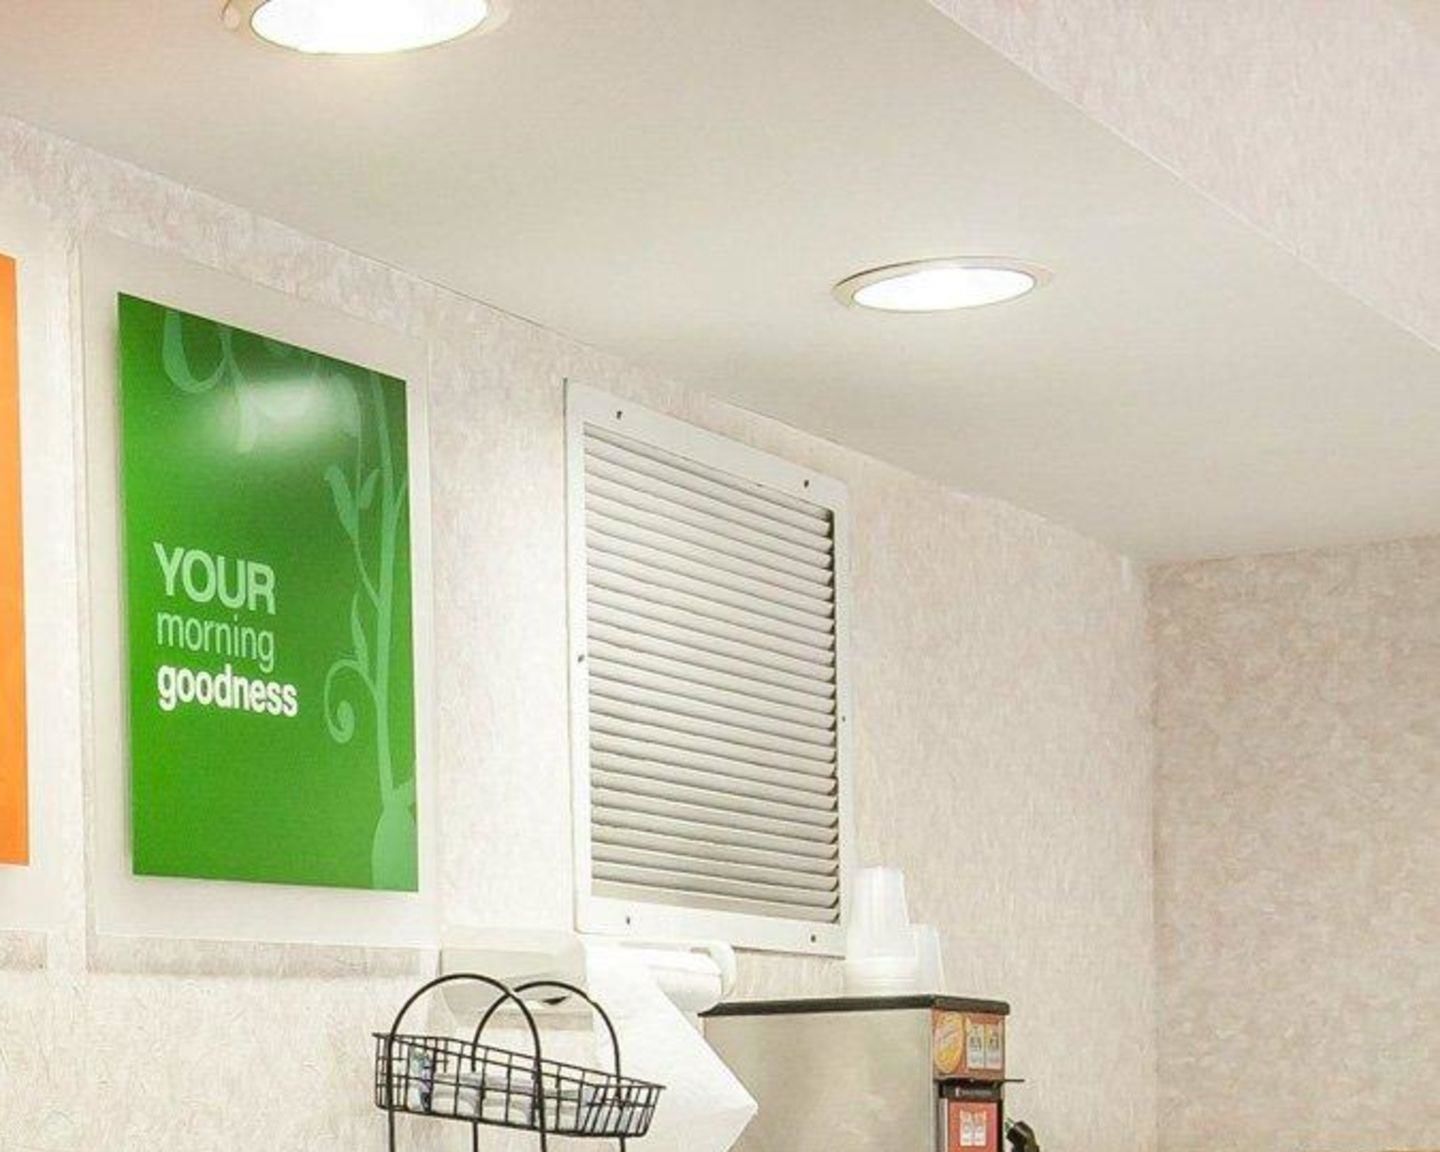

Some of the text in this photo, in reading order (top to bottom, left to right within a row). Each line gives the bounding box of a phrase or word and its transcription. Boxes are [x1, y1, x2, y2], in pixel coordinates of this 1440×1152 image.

[153, 541, 277, 615] YOUR
[157, 612, 274, 674] morning
[157, 663, 298, 717] goodness
